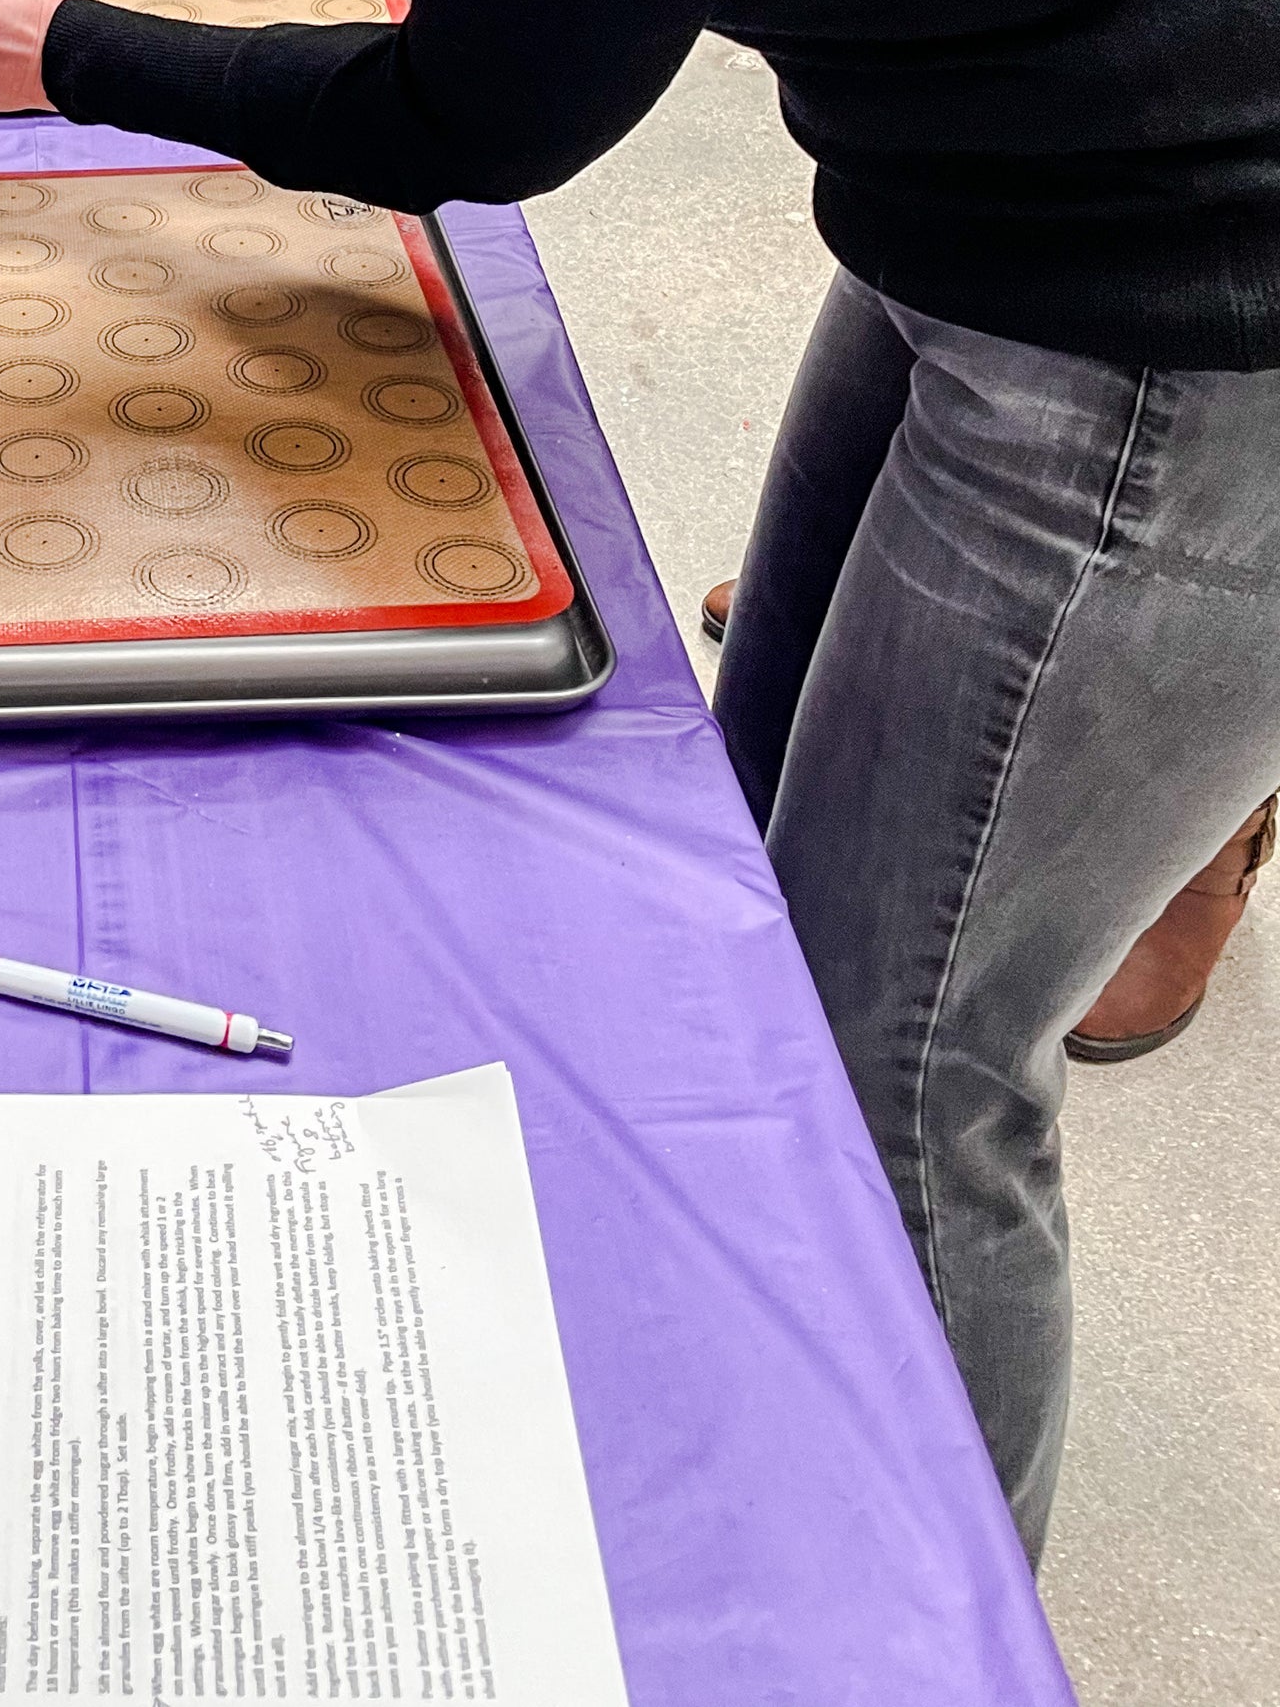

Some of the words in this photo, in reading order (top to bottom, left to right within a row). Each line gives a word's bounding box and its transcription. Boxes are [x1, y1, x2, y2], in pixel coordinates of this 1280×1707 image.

[36, 1179, 48, 1229] refrigerator
[139, 1169, 149, 1218] attachment
[359, 1184, 371, 1208] fitted
[139, 1221, 150, 1246] whisk
[364, 1210, 376, 1238] sheets
[35, 1231, 45, 1246] the
[141, 1249, 150, 1269] with
[368, 1241, 379, 1270] baking
[34, 1259, 44, 1278] chill
[142, 1272, 151, 1298] mixer
[372, 1273, 383, 1294] onto
[34, 1296, 44, 1314] and
[142, 1301, 152, 1327] stand
[374, 1297, 387, 1326] circles
[144, 1349, 154, 1374] them
[382, 1351, 394, 1373] Pipe
[32, 1376, 43, 1392] the
[31, 1394, 42, 1419] from
[144, 1376, 157, 1421] whipping
[386, 1398, 400, 1428] round
[31, 1422, 42, 1458] whites
[145, 1424, 158, 1453] begin
[393, 1431, 404, 1456] large
[33, 1461, 44, 1480] egg
[395, 1468, 408, 1492] with
[30, 1484, 41, 1503] the
[67, 1501, 79, 1535] stiffer
[398, 1494, 412, 1526] fitted
[31, 1506, 42, 1555] separate
[403, 1528, 415, 1549] bag
[150, 1536, 159, 1566] room
[67, 1548, 79, 1584] makes
[407, 1553, 422, 1588] piping
[151, 1570, 160, 1588] are
[67, 1588, 81, 1613] (this
[149, 1592, 161, 1630] whites
[27, 1602, 39, 1642] before
[412, 1601, 424, 1626] into
